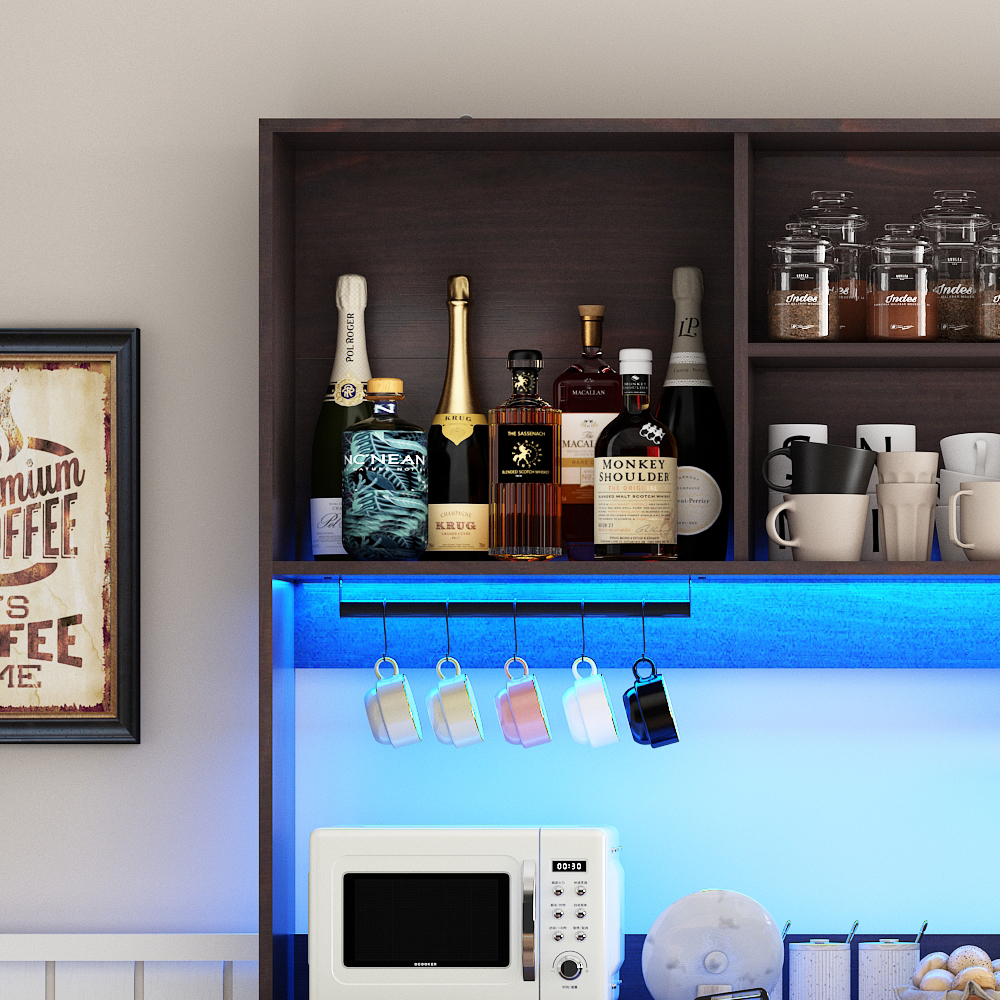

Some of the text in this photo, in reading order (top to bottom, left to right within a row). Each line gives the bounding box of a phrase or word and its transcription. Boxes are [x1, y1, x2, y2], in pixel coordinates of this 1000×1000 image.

[346, 313, 355, 344] ROGER
[562, 439, 595, 448] MACAL
[602, 459, 666, 470] MONKEY
[0, 457, 86, 507] mium
[599, 471, 671, 482] SHOULDER
[3, 491, 78, 559] FFEE
[435, 521, 477, 531] KRUG
[0, 613, 83, 668] FEE
[0, 664, 42, 688] ME
[556, 862, 582, 870] 00:30
